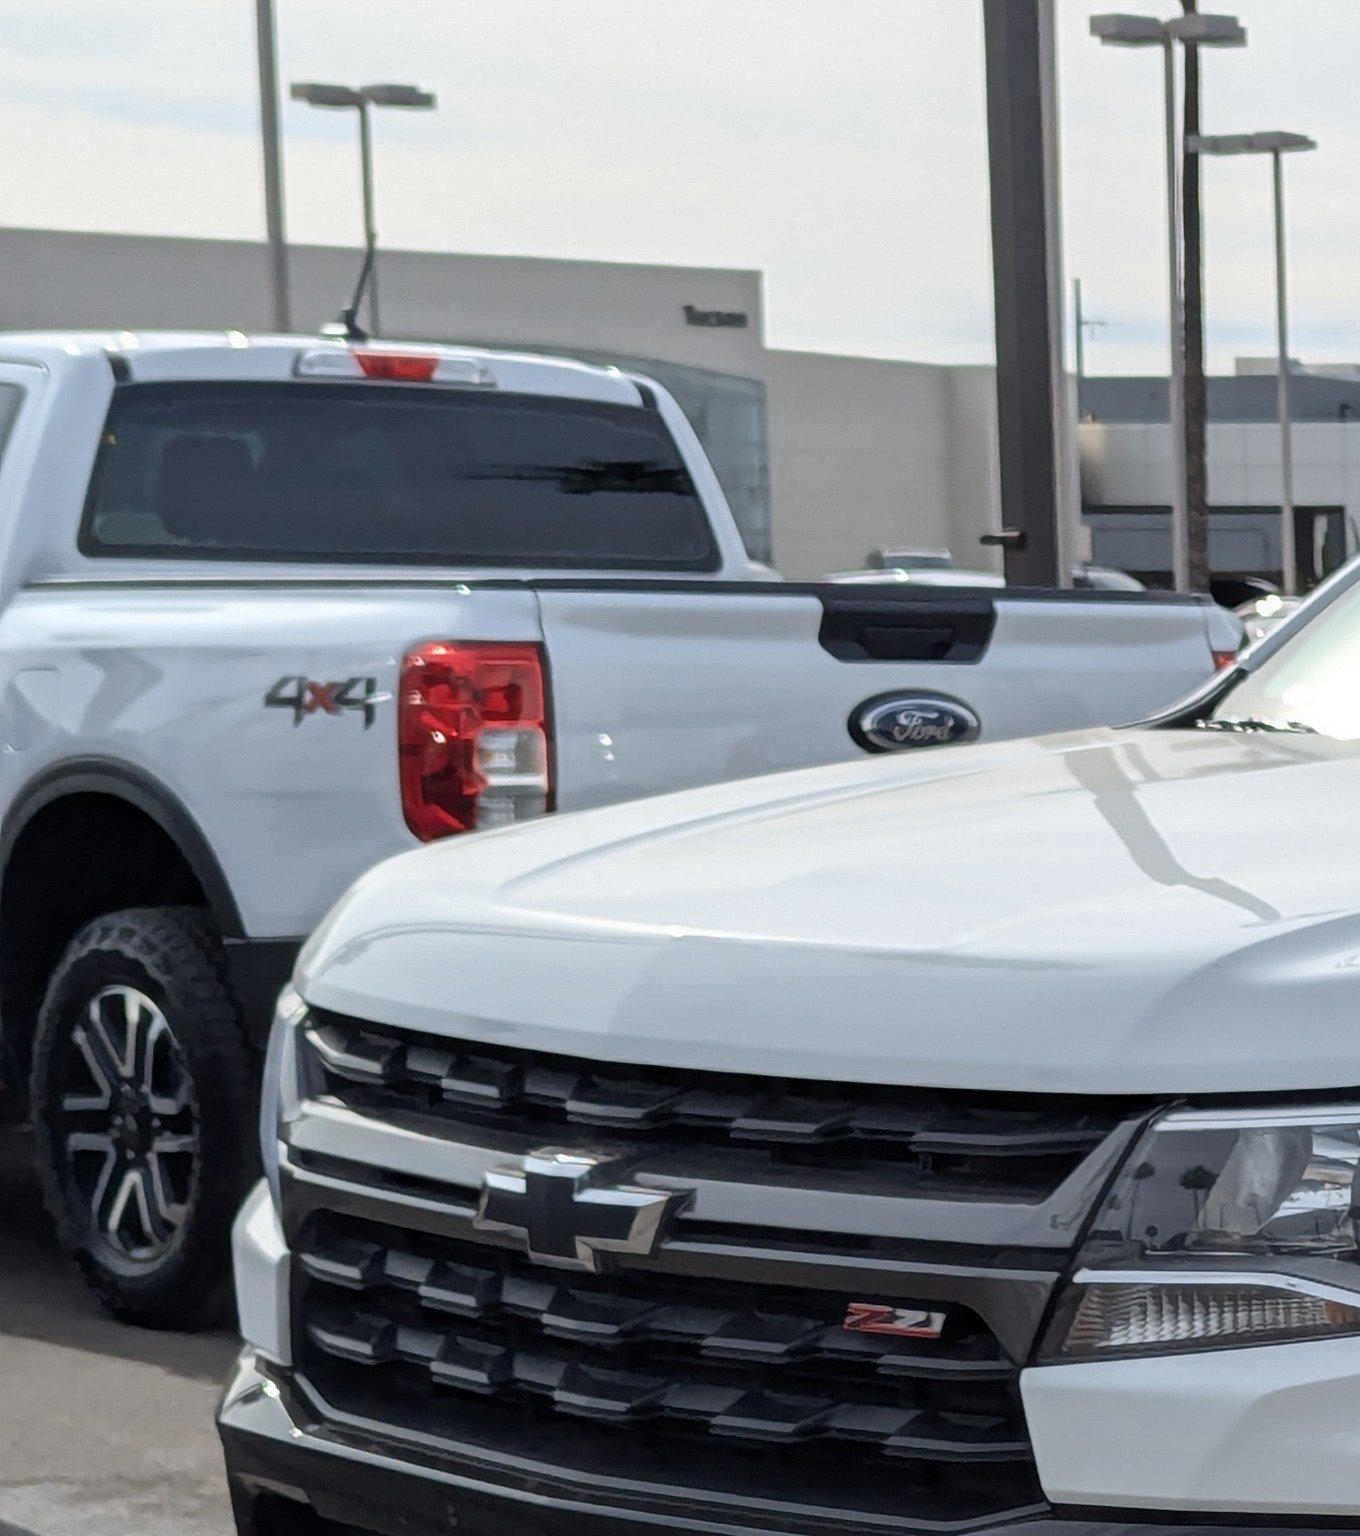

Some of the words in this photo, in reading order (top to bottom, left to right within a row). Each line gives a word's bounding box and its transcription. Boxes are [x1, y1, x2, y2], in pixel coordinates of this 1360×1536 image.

[264, 676, 377, 730] 4x4
[892, 710, 955, 742] Ford
[842, 1302, 948, 1340] Z71
